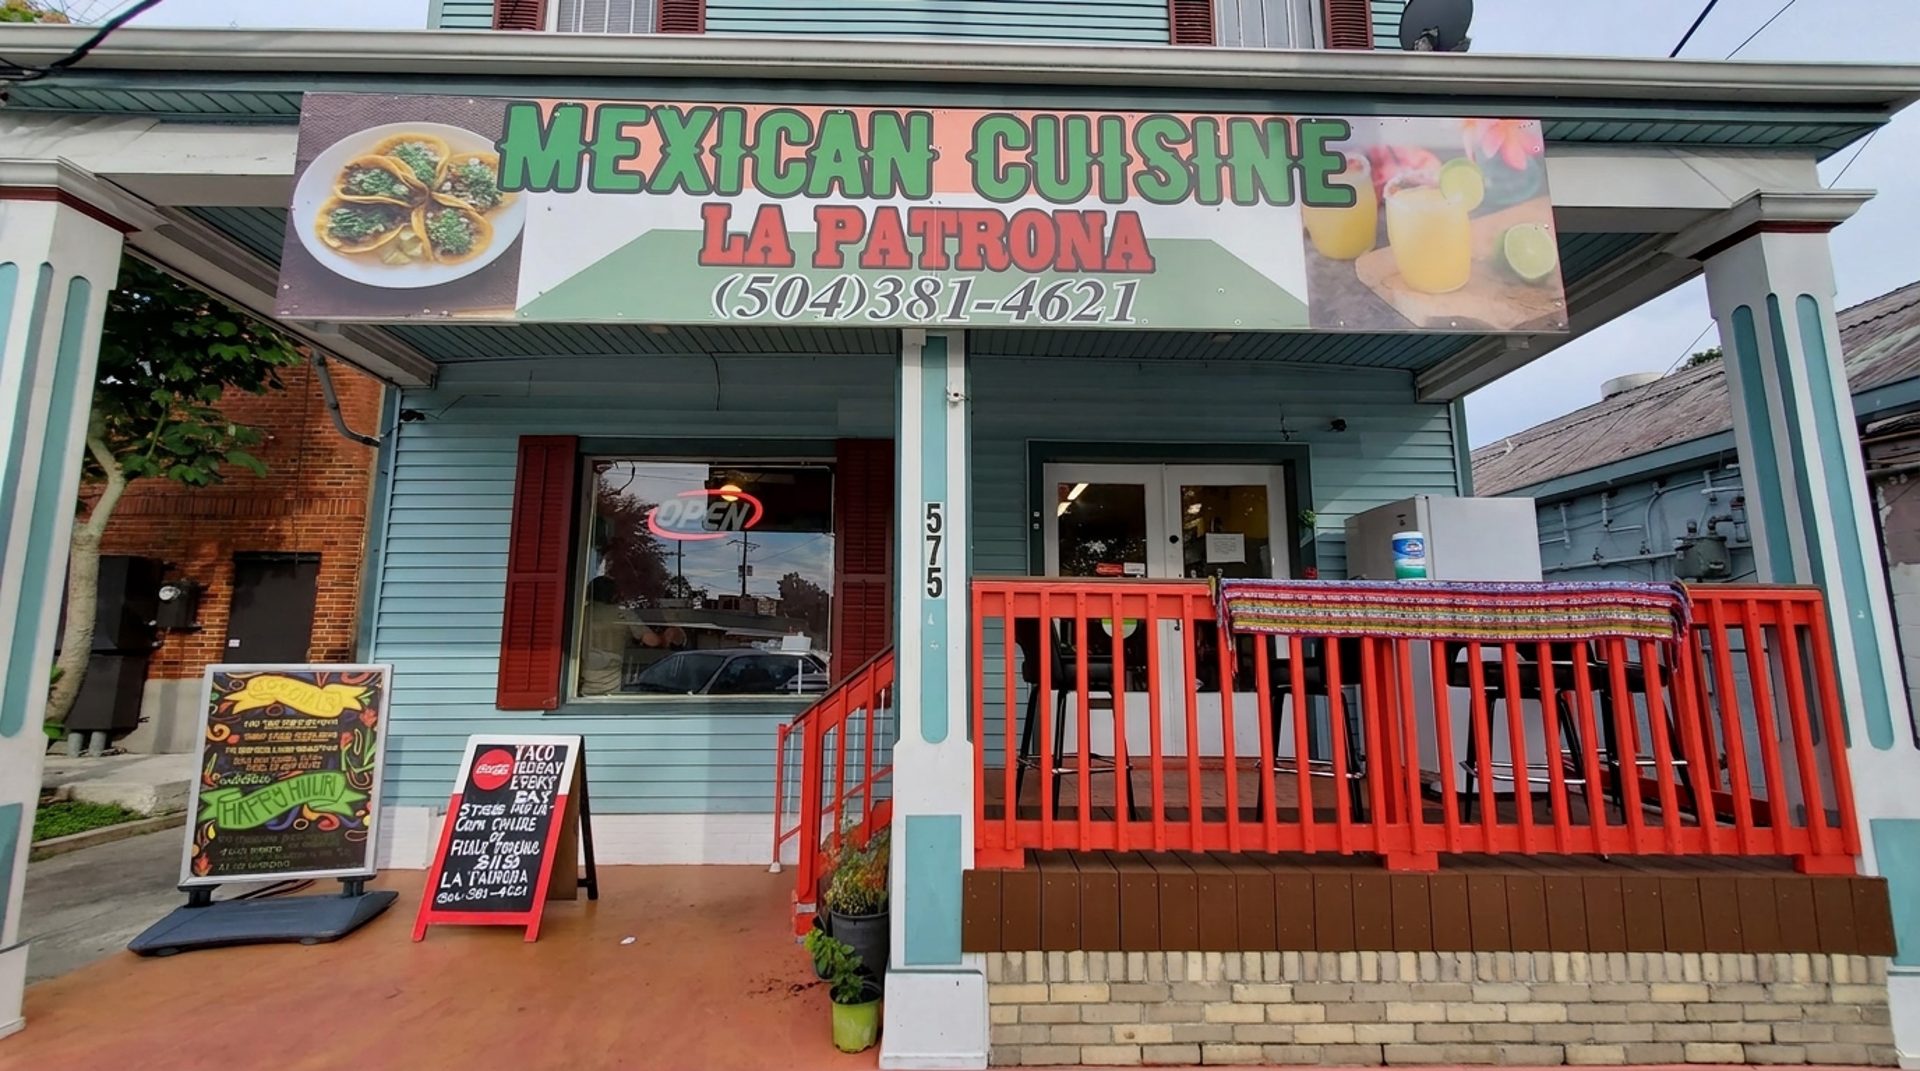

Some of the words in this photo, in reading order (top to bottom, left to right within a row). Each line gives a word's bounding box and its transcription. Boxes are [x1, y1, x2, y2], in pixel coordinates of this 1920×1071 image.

[495, 101, 940, 199] MEXICAN
[966, 113, 1357, 208] CUISINE
[699, 203, 795, 269] LA
[812, 205, 1156, 274] PATRONA
[712, 273, 1141, 325] (504)381-4621
[656, 500, 751, 532] OPEN
[926, 503, 943, 598] 575
[515, 745, 555, 760] TACO
[224, 786, 289, 825] HAPPY
[441, 872, 463, 888] LA
